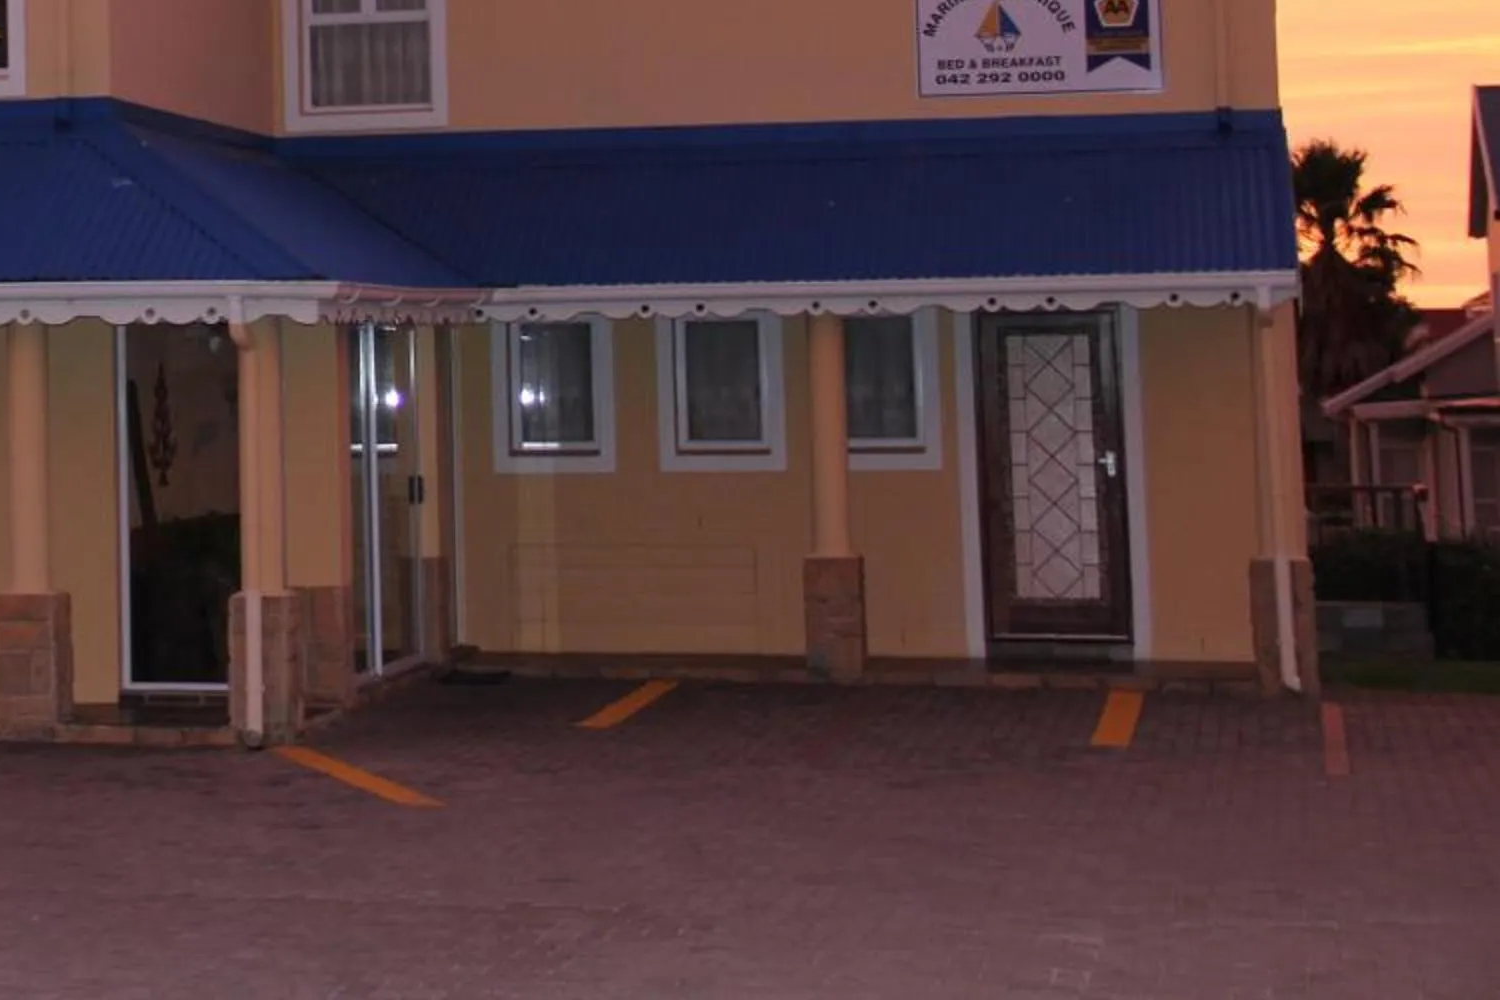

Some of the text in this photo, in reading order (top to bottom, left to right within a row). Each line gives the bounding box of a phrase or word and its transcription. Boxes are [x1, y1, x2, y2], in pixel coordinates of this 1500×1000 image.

[1104, 0, 1129, 14] AA
[937, 56, 1062, 70] BED & BREAKFAST
[935, 73, 971, 85] 042
[977, 72, 1012, 84] 292
